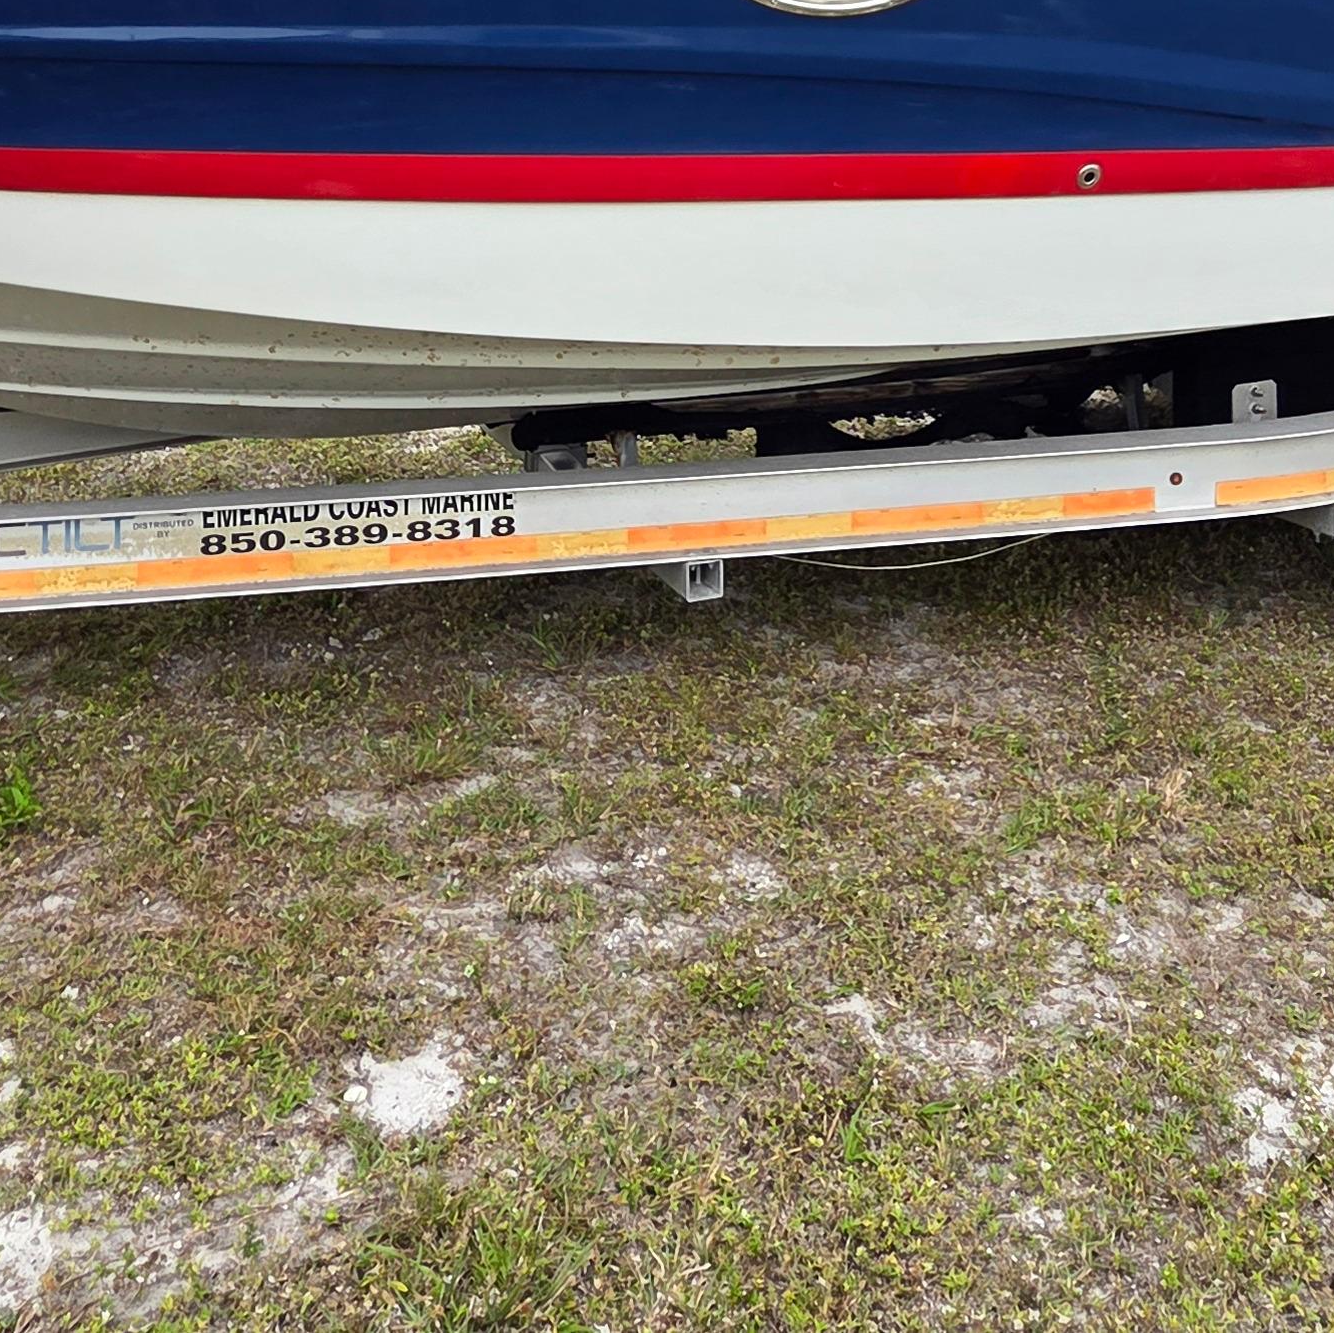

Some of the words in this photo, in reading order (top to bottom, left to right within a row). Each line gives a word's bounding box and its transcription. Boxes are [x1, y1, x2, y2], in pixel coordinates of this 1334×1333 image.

[201, 504, 321, 529] EMERALD
[327, 497, 412, 521] COAST
[421, 491, 515, 515] MARINE
[132, 518, 195, 531] DISTRIBUTED
[155, 530, 171, 539] BY
[199, 515, 517, 556] 850-389-8318
